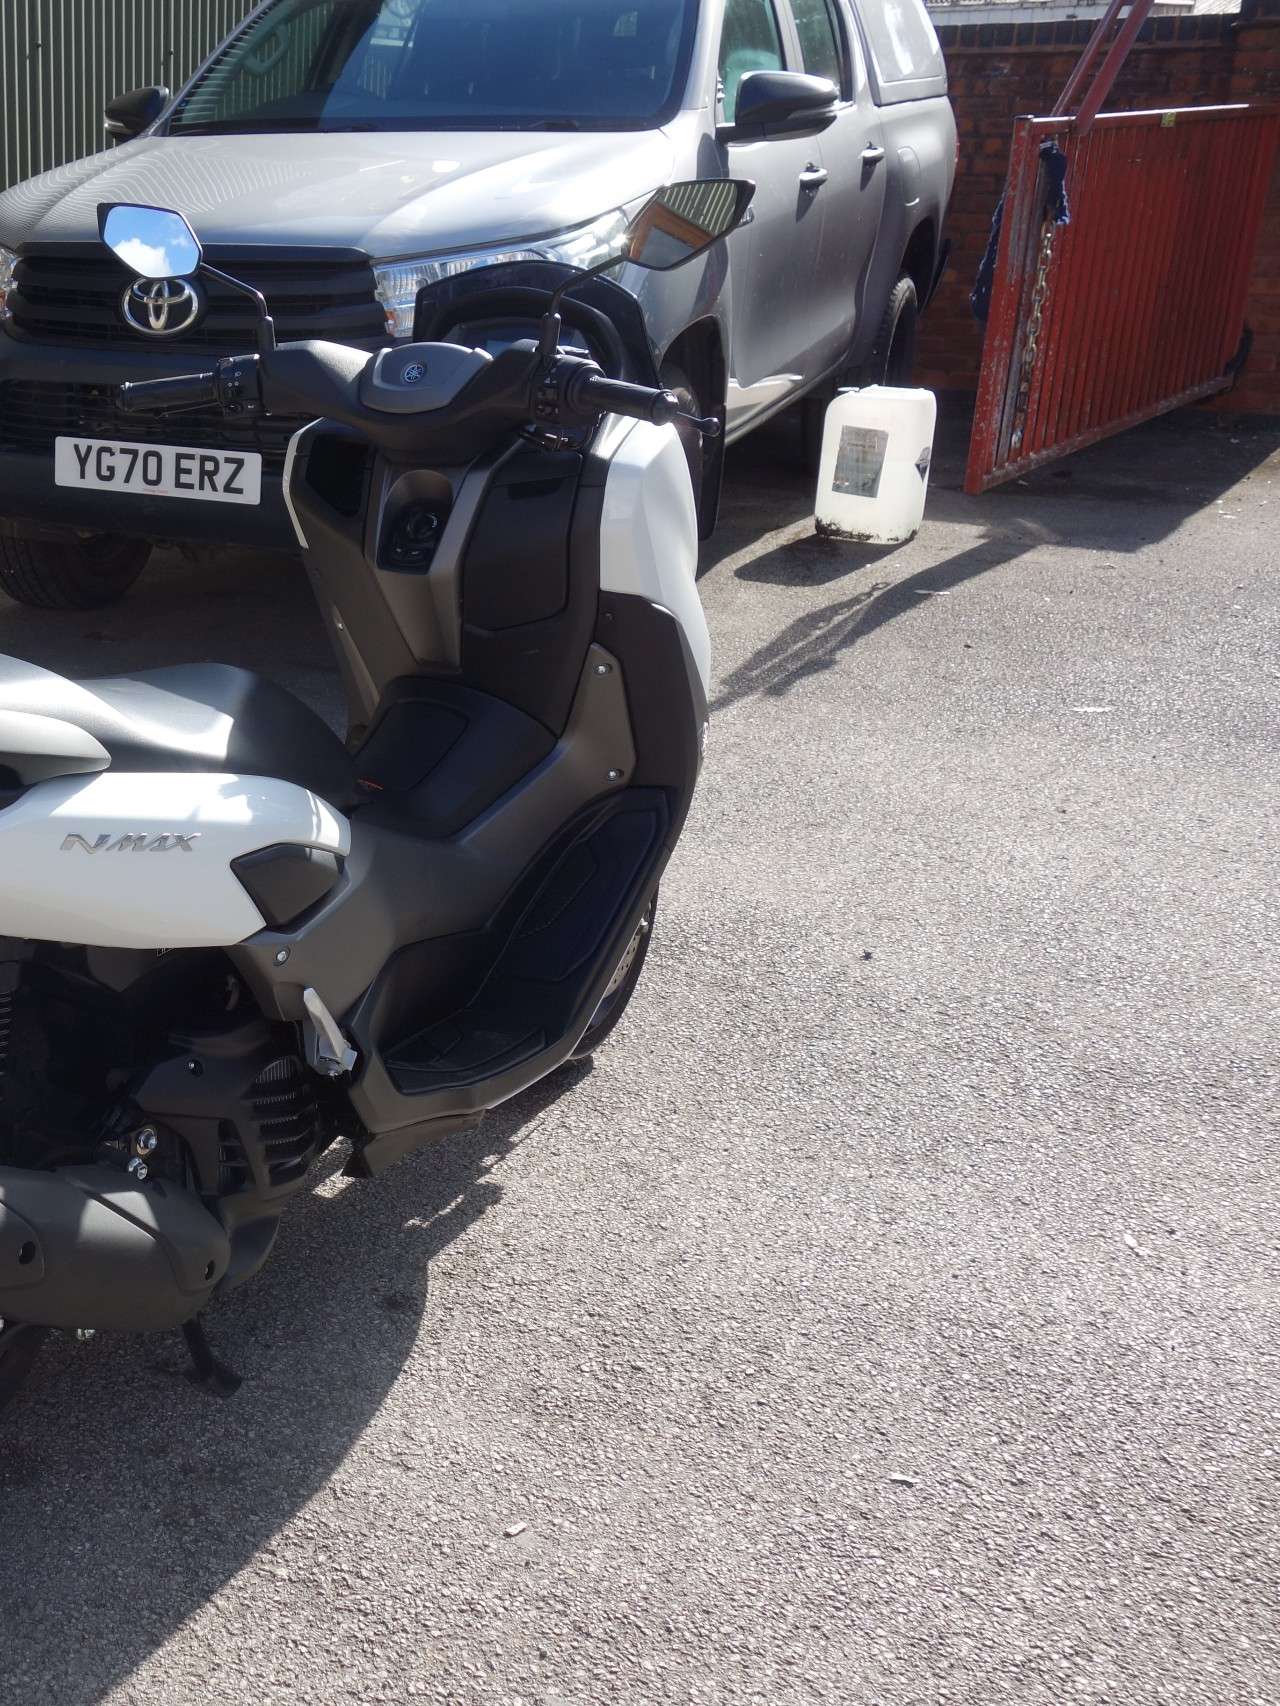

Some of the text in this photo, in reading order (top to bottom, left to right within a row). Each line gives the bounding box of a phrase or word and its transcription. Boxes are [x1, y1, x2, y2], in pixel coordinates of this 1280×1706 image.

[73, 443, 245, 495] YG70 ERZ
[60, 832, 201, 854] NMAX
